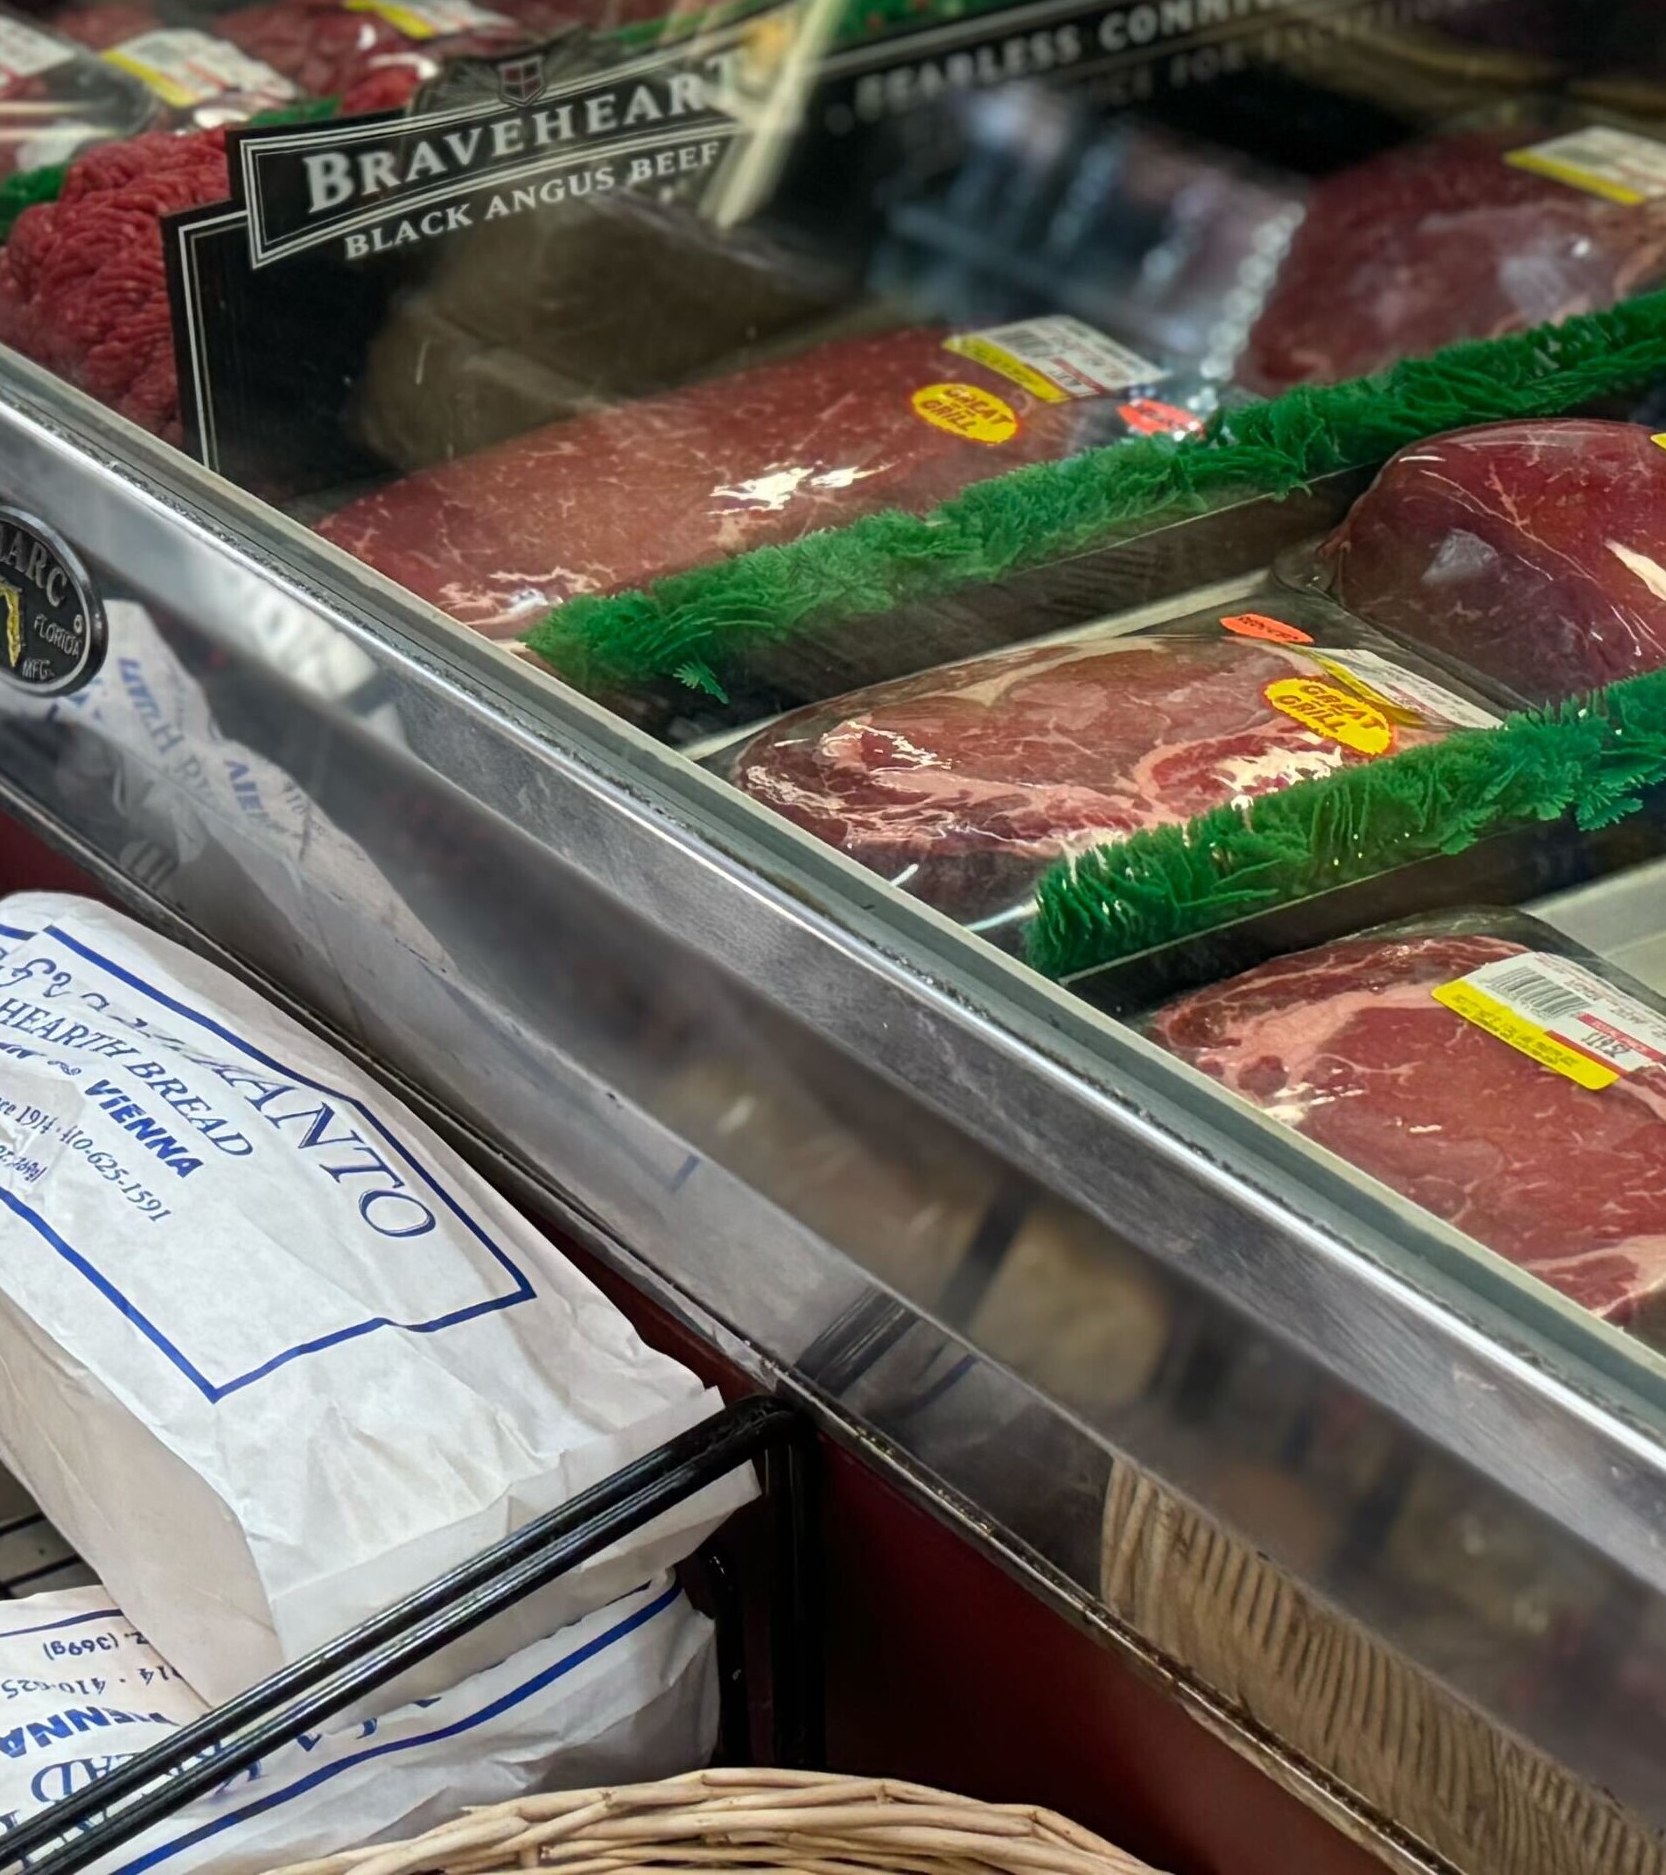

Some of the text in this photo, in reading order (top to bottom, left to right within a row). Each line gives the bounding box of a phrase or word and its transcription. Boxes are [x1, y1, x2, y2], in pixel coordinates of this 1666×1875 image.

[855, 24, 1082, 122] FEARLESS
[345, 141, 722, 262] BLACK ANGUS BEEF
[33, 613, 81, 659] FLORIDA
[21, 657, 56, 680] MFG.
[1274, 694, 1347, 734] GRILL
[1298, 683, 1382, 729] GREAT
[14, 1105, 55, 1136] 1914
[124, 1049, 255, 1157] BREAD
[83, 1078, 205, 1179] VIENNA
[42, 1631, 120, 1662] (369g)
